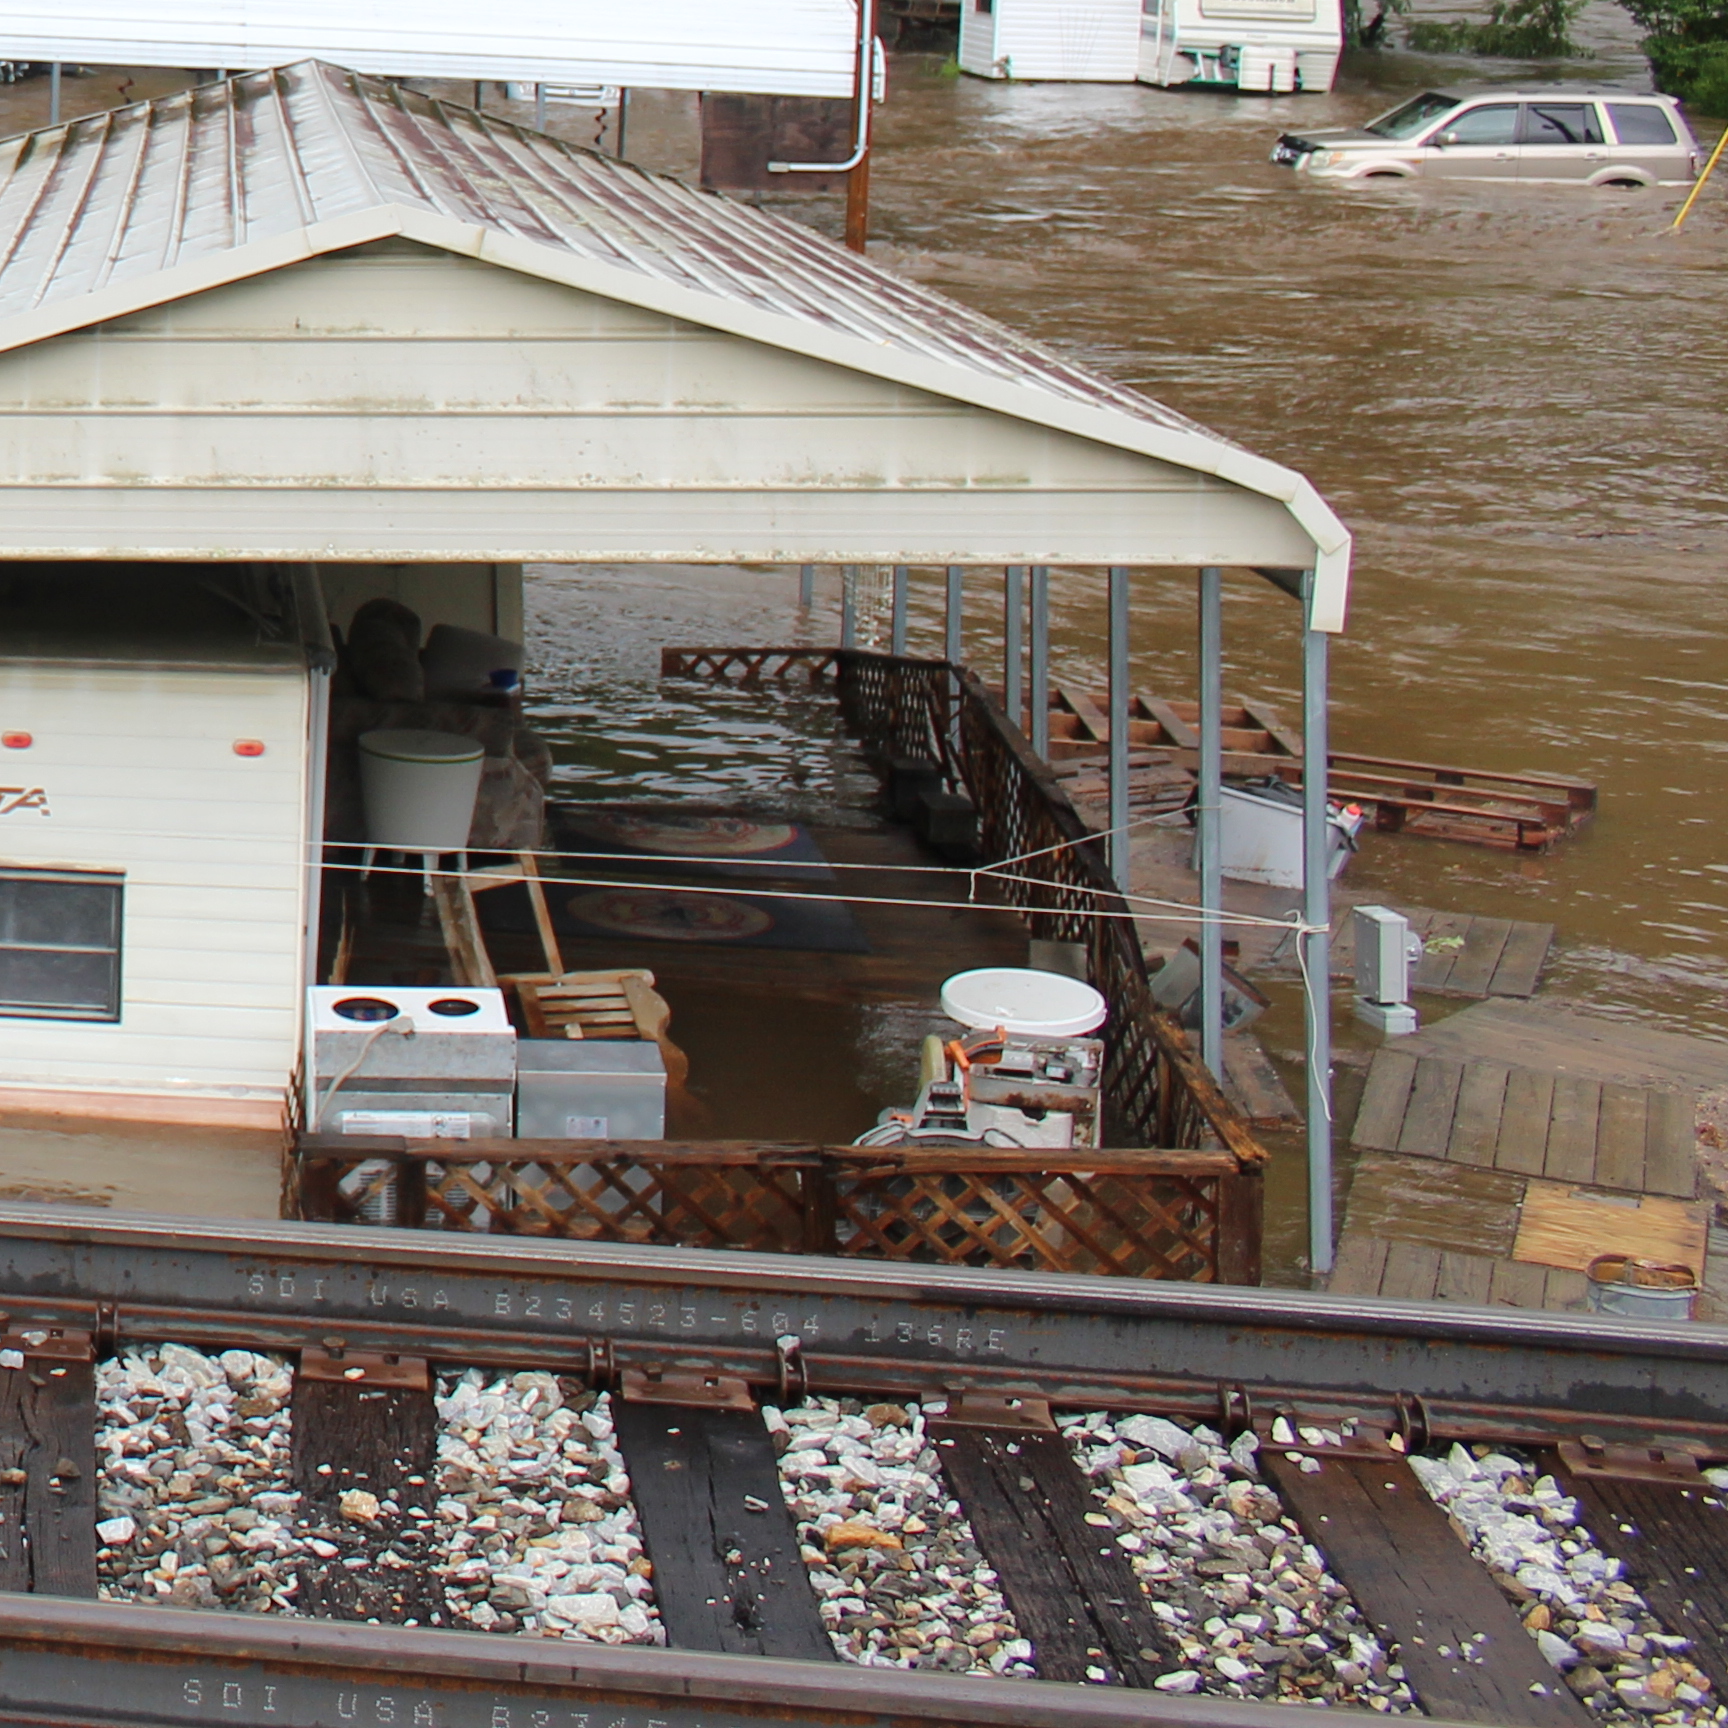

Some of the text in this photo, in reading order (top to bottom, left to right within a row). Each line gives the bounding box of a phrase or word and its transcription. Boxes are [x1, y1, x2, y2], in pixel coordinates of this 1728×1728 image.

[247, 1274, 1005, 1352] SDI USA B234523-604 136RE
[182, 1677, 279, 1713] SDI
[336, 1691, 436, 1727] USA
